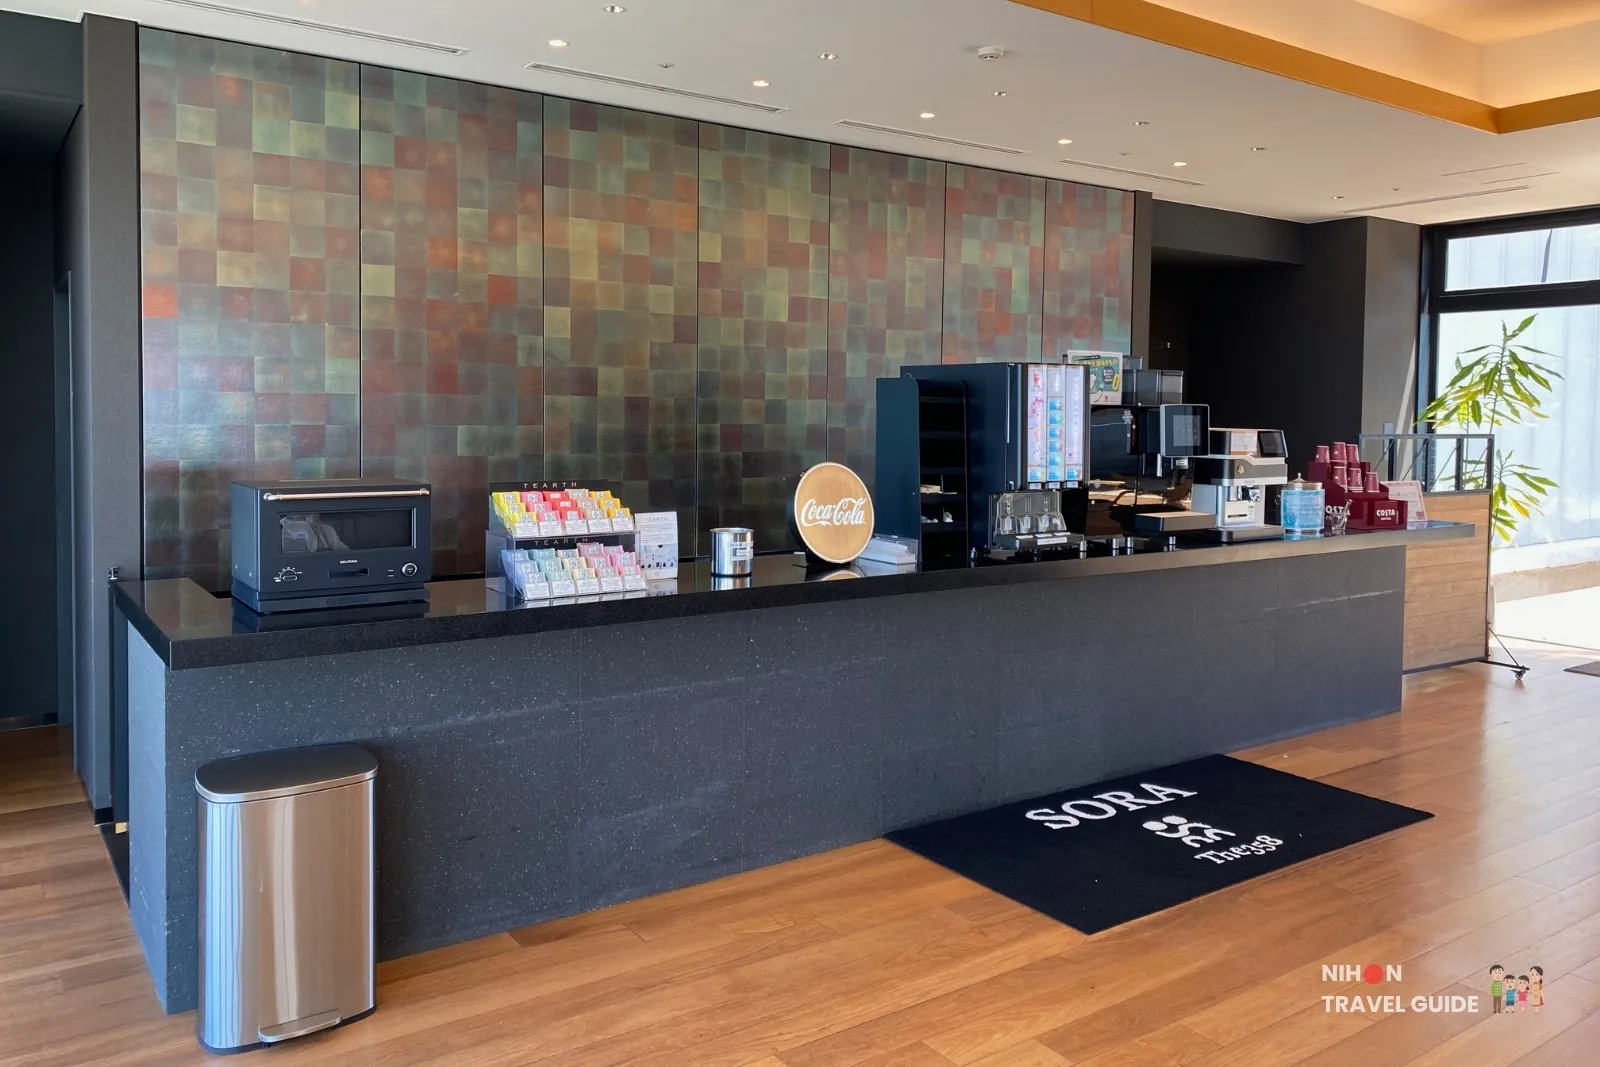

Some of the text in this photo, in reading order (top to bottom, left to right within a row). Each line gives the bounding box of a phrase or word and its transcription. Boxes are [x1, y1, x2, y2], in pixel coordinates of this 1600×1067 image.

[523, 481, 577, 489] TEARTH
[800, 497, 867, 527] Coca-Cola
[1376, 509, 1396, 517] COSTA
[534, 538, 588, 546] TEARTH
[1025, 783, 1198, 830] SORA
[1193, 834, 1284, 865] The358
